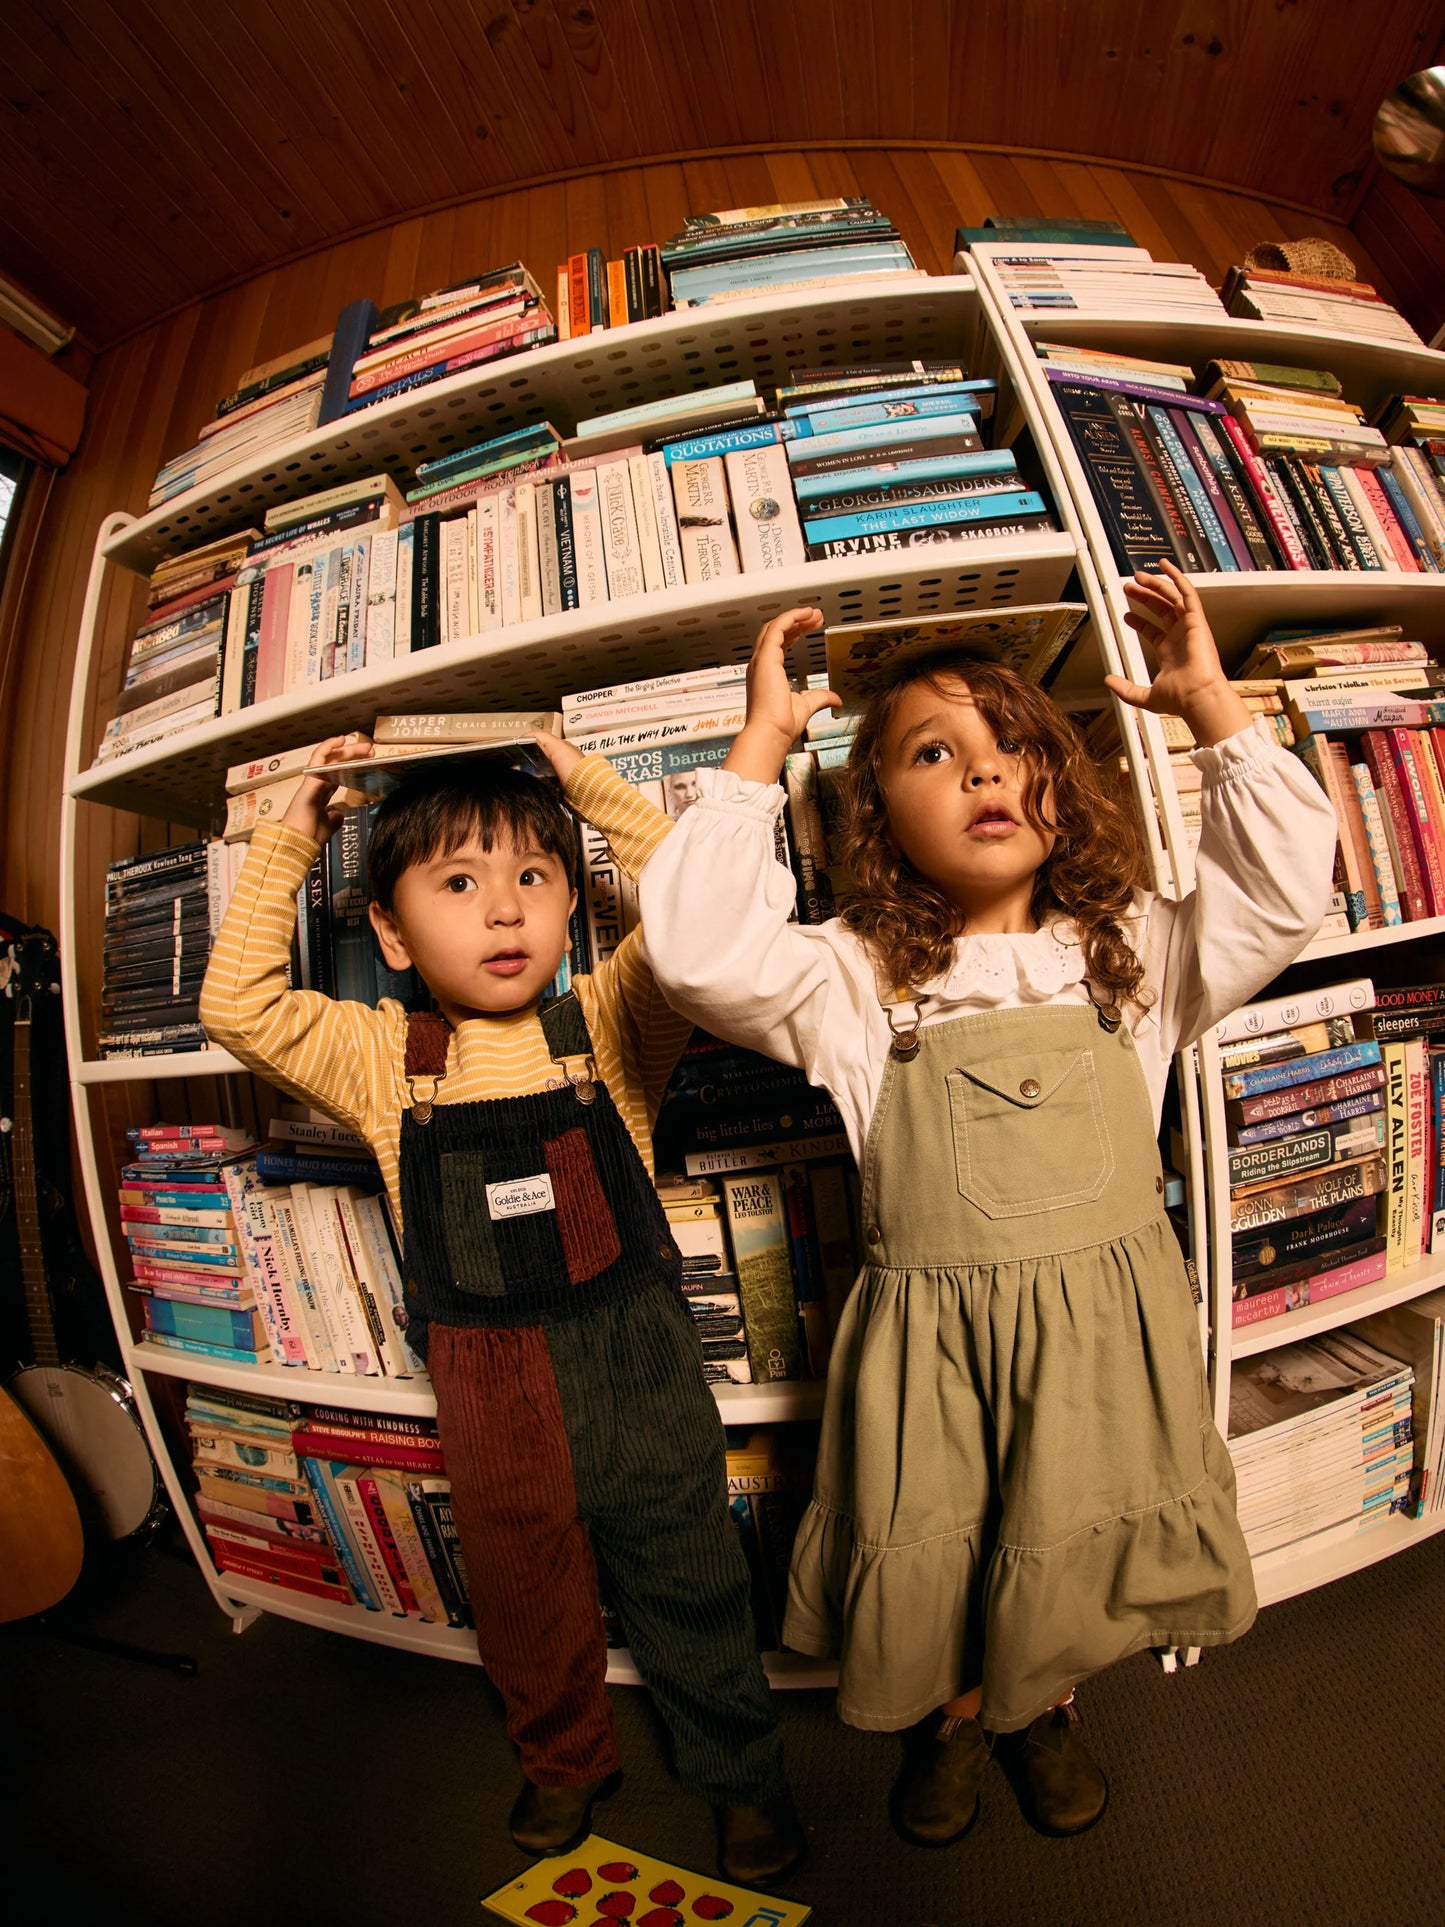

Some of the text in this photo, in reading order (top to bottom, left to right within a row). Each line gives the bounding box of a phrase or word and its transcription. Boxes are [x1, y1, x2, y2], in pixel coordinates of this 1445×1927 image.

[376, 366, 434, 397] DETAILS
[670, 429, 774, 461] QUOTATIONS
[1083, 429, 1120, 442] AUSTEN
[1154, 413, 1186, 470] OURSELVES
[522, 457, 595, 481] JAMIE DURIE
[743, 453, 761, 497] MARTIN
[1197, 422, 1252, 522] HANNAH KENT
[685, 464, 702, 507] MARTIN
[1130, 427, 1187, 537] ALMOST CHIMPANZEE
[1155, 435, 1206, 538] THE TATTOOIST OF AUSCHWITZ
[409, 476, 517, 516] THE OUTDOOR ROOM
[818, 477, 1005, 512] GEORGE SAUNDERS
[1329, 471, 1366, 533] PATTERSON
[855, 499, 982, 523] KARIN SLAUGHTER
[860, 507, 981, 531] THE LAST WIDOW
[1192, 490, 1219, 543] HOROWITZ
[1198, 488, 1226, 546] ALEXANDRA
[254, 517, 332, 549] THE SECRET LIFE OF WHALES
[583, 514, 592, 548] MEMOIRS
[960, 525, 1026, 541] SKAGBOYS
[1266, 498, 1304, 562] WETLANDS
[560, 529, 573, 576] VIETNAM
[586, 550, 593, 560] OF
[823, 533, 902, 553] IRVINE
[696, 534, 712, 582] THRONES
[338, 556, 351, 604] DISGRACE
[587, 571, 597, 601] GEISHA
[576, 689, 613, 703] CHOPPER
[624, 685, 634, 694] The
[635, 681, 656, 693] Singing
[656, 677, 682, 689] Defective
[1304, 683, 1337, 693] Christos
[1338, 680, 1369, 690] Tsiolkas
[1370, 678, 1385, 687] The
[390, 716, 446, 728] JASPER
[455, 719, 529, 729] CRAIG SILVEY
[585, 704, 659, 721] DAVID MITCHELL
[1321, 707, 1367, 719] MARY ANN
[1329, 716, 1370, 728] AUTUMN
[393, 726, 442, 737] JONES
[599, 736, 617, 750] ALL
[618, 734, 635, 746] THE
[638, 729, 660, 743] WAY
[661, 724, 689, 738] DOWN
[692, 718, 719, 732] JOHN
[341, 815, 360, 879] LARSSON
[106, 853, 193, 883] PAUL THEROUX Kowloon Tong
[801, 856, 815, 891] SING
[310, 877, 323, 909] SEX
[1374, 989, 1439, 1008] BLOOD MONEY
[1377, 1016, 1420, 1034] sleepers
[1249, 1066, 1311, 1088] CHARLAINE HARRIS
[1336, 1071, 1377, 1089] CHARLAINE
[1345, 1082, 1372, 1096] HARRIS
[1389, 1059, 1404, 1108] LILY
[699, 1075, 806, 1105] CRYPTONOMIC
[1330, 1094, 1372, 1112] CHARLAINE
[1339, 1104, 1367, 1119] HARRIS
[1409, 1071, 1423, 1160] ZOË FOSTER
[142, 1128, 164, 1137] Italian
[288, 1123, 328, 1142] Stanley
[696, 1118, 774, 1142] big little lies
[151, 1141, 178, 1151] Spanish
[1232, 1136, 1327, 1171] BORDERLANDS
[1391, 1117, 1405, 1194] ALLEN
[263, 1155, 369, 1173] HONEY MUD MAGGOTS
[699, 1154, 747, 1172] BUTLER
[1240, 1151, 1320, 1179] Riding the Slipstream
[731, 1183, 771, 1201] WAR &
[1314, 1173, 1357, 1197] WOLF OF
[494, 1190, 546, 1206] Goldie & Ace
[506, 1202, 537, 1210] AUSTRALIA
[732, 1195, 774, 1213] PEACE
[1236, 1197, 1273, 1218] CONN
[1309, 1184, 1364, 1211] THE PLAINS
[734, 1207, 774, 1220] LEO TOLSTOY
[1286, 1226, 1350, 1252] FRANK MOORHOUSE
[1291, 1219, 1346, 1242] Dark Palace
[261, 1246, 292, 1333] Nick Hornby
[1234, 1303, 1281, 1325] mccarthy
[1236, 1292, 1280, 1313] maureen
[769, 1368, 787, 1379] Pan
[314, 1408, 421, 1435] COOKING WITH KINDNESS
[311, 1424, 330, 1434] STEVE
[369, 1432, 415, 1447] RAISING
[417, 1437, 442, 1450] BOY
[728, 1475, 784, 1491] AUSTR
